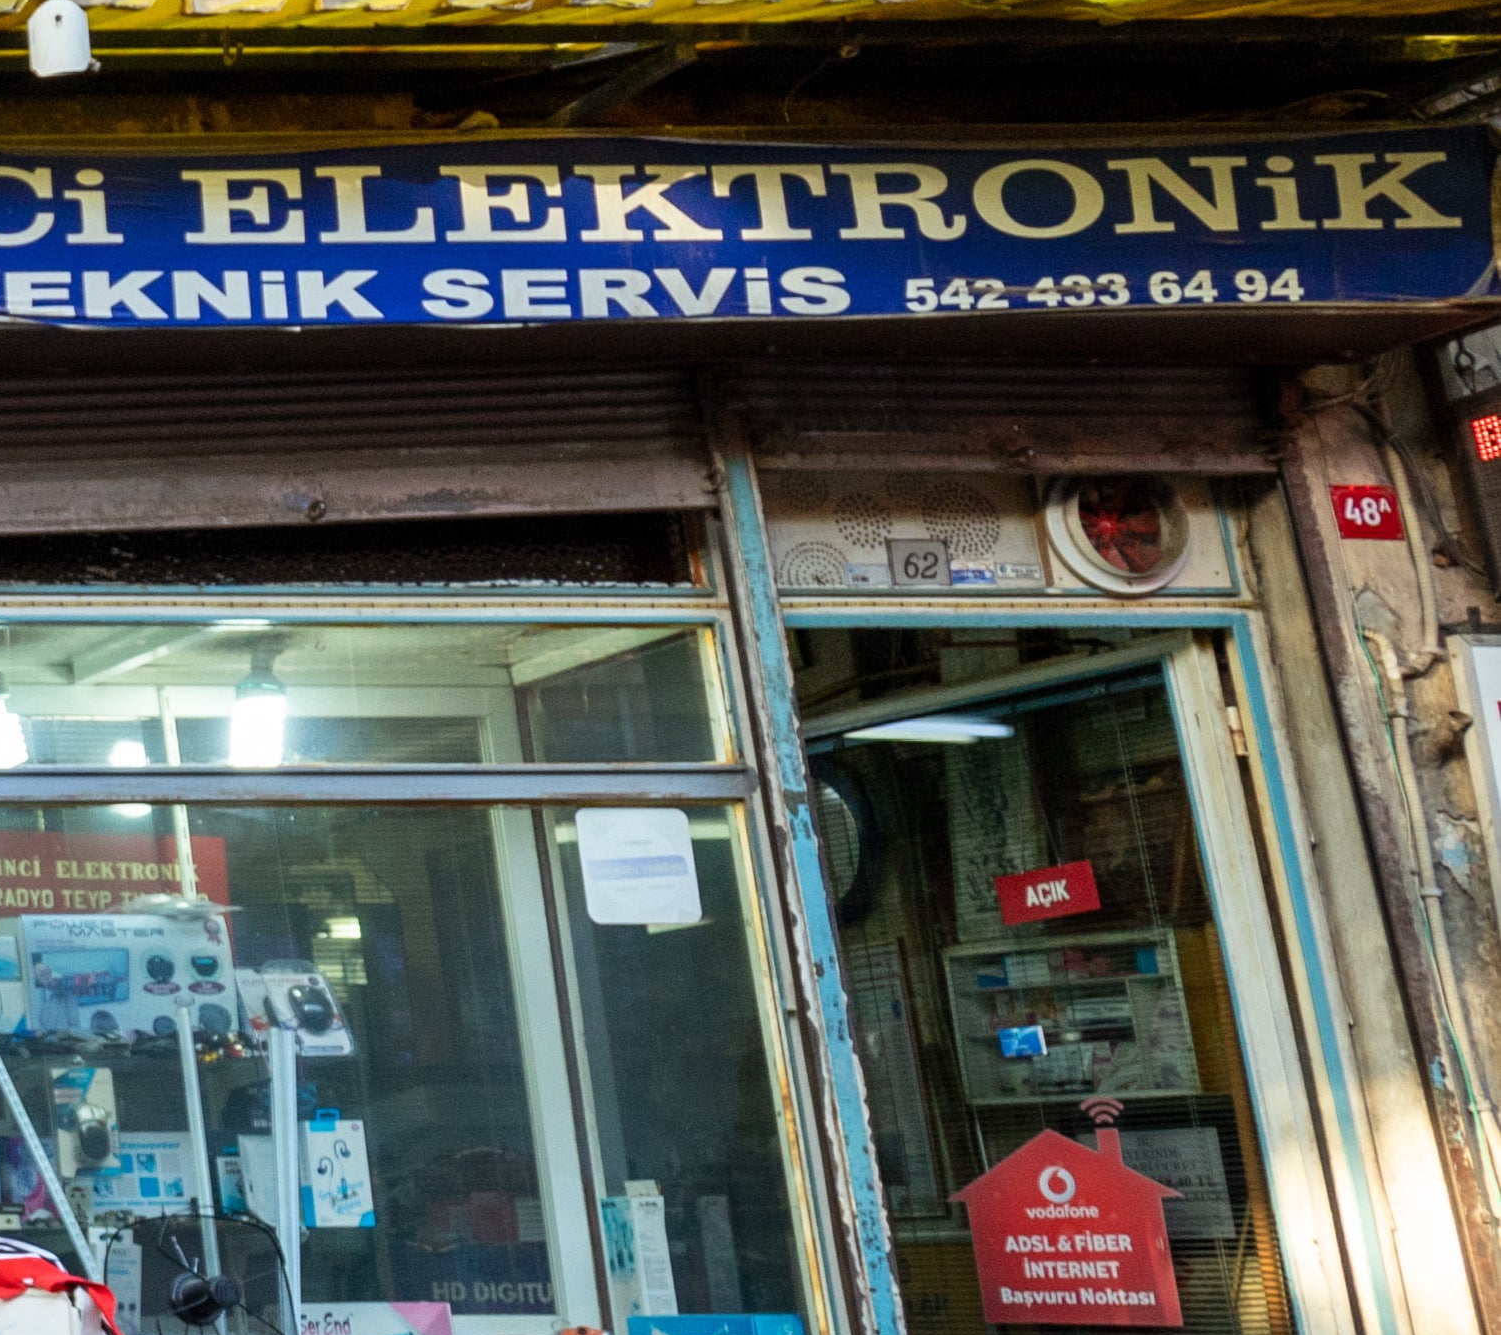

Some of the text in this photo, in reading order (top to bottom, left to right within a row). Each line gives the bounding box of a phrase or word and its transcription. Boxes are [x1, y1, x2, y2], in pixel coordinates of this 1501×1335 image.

[905, 278, 1010, 313] 542
[1027, 274, 1131, 309] 433
[1149, 271, 1219, 305] 64
[1236, 268, 1304, 302] 94
[1344, 497, 1392, 527] 48A
[904, 552, 939, 580] 62
[62, 890, 112, 910] TEYP
[1025, 878, 1071, 908] AÇIK
[1024, 1203, 1100, 1220] vodafone
[1005, 1230, 1134, 1253] ADSL & FİBER
[1023, 1257, 1120, 1280] İNTERNET
[432, 1280, 467, 1302] HD
[1000, 1285, 1157, 1308] Başvuru Noktası
